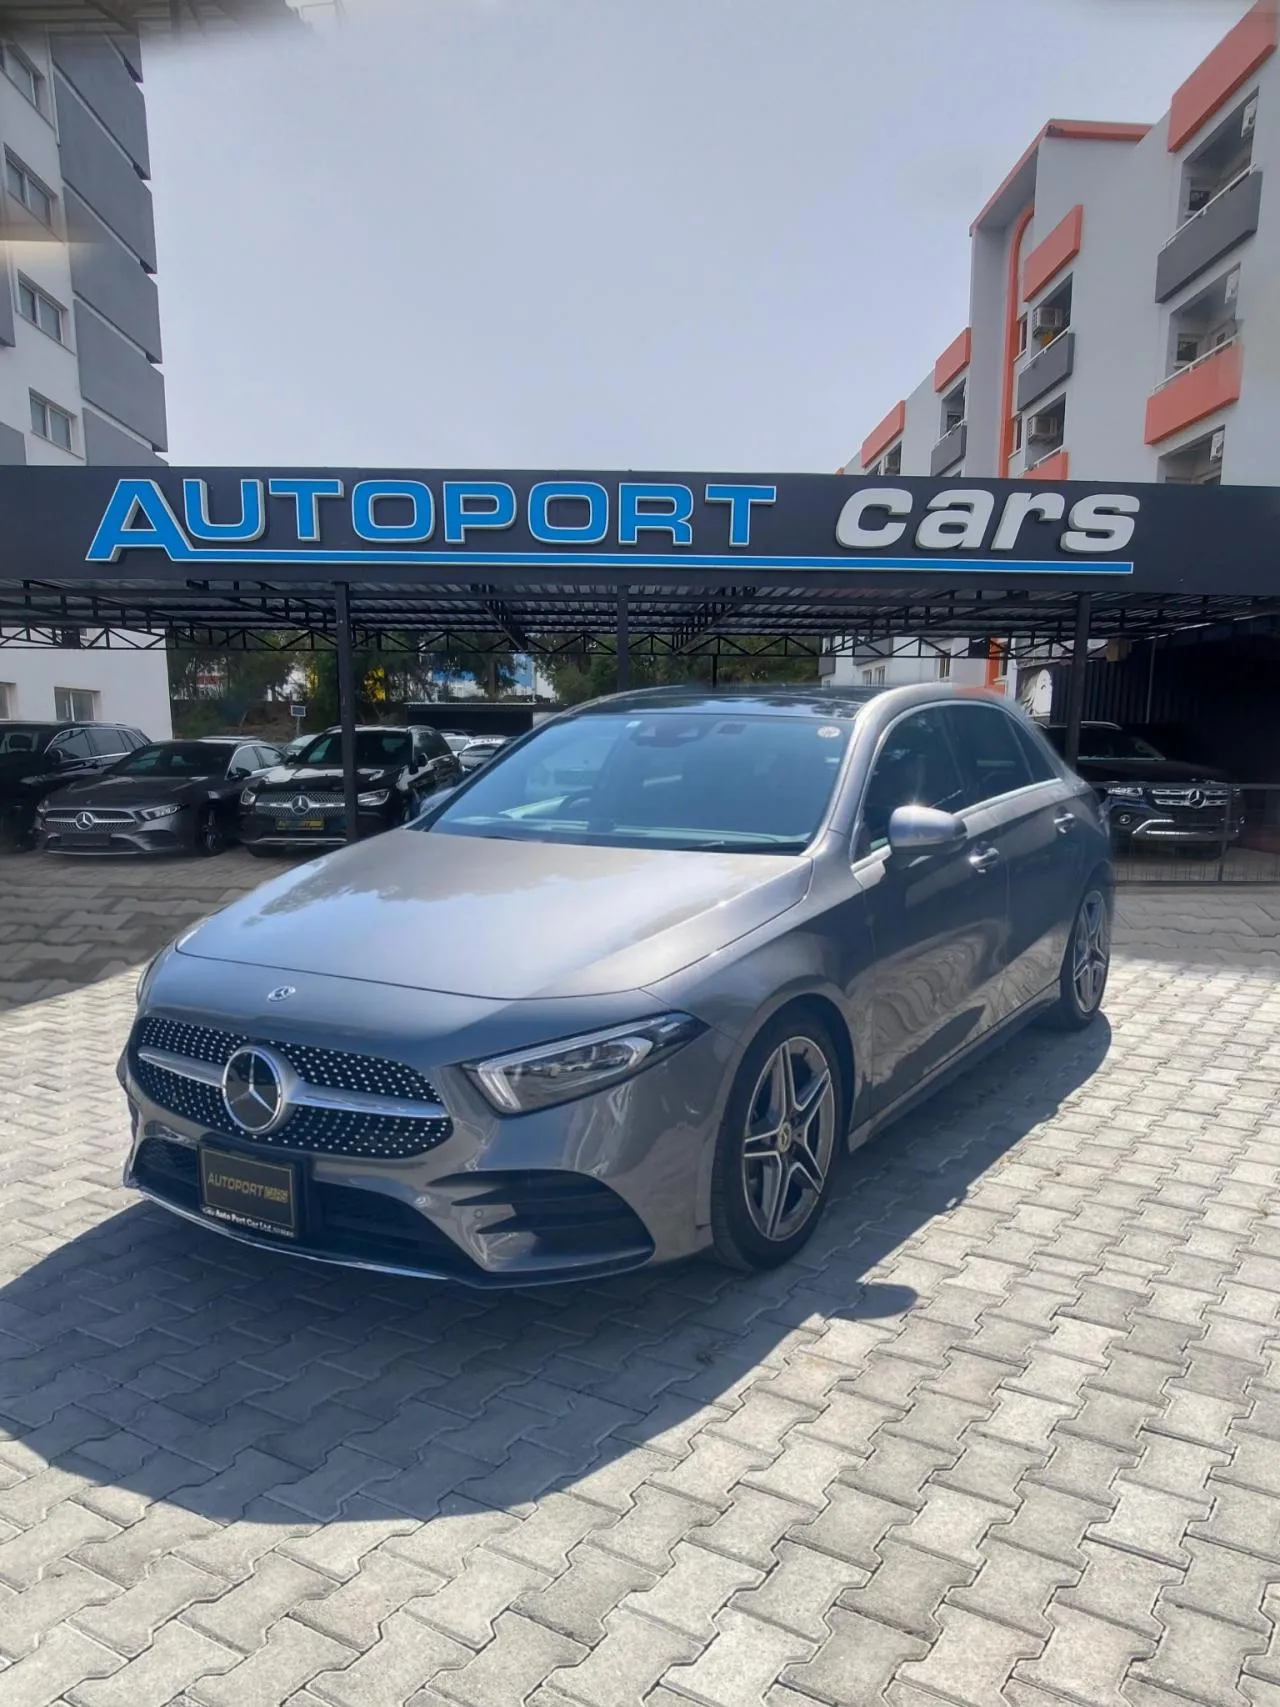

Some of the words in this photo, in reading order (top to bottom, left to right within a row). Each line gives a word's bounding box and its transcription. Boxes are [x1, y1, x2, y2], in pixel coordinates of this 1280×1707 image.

[85, 478, 778, 563] AUTOPORT
[835, 487, 1141, 553] cars
[208, 1172, 264, 1196] AUTOPORT
[216, 1209, 231, 1220] Auto
[231, 1213, 245, 1224] Port
